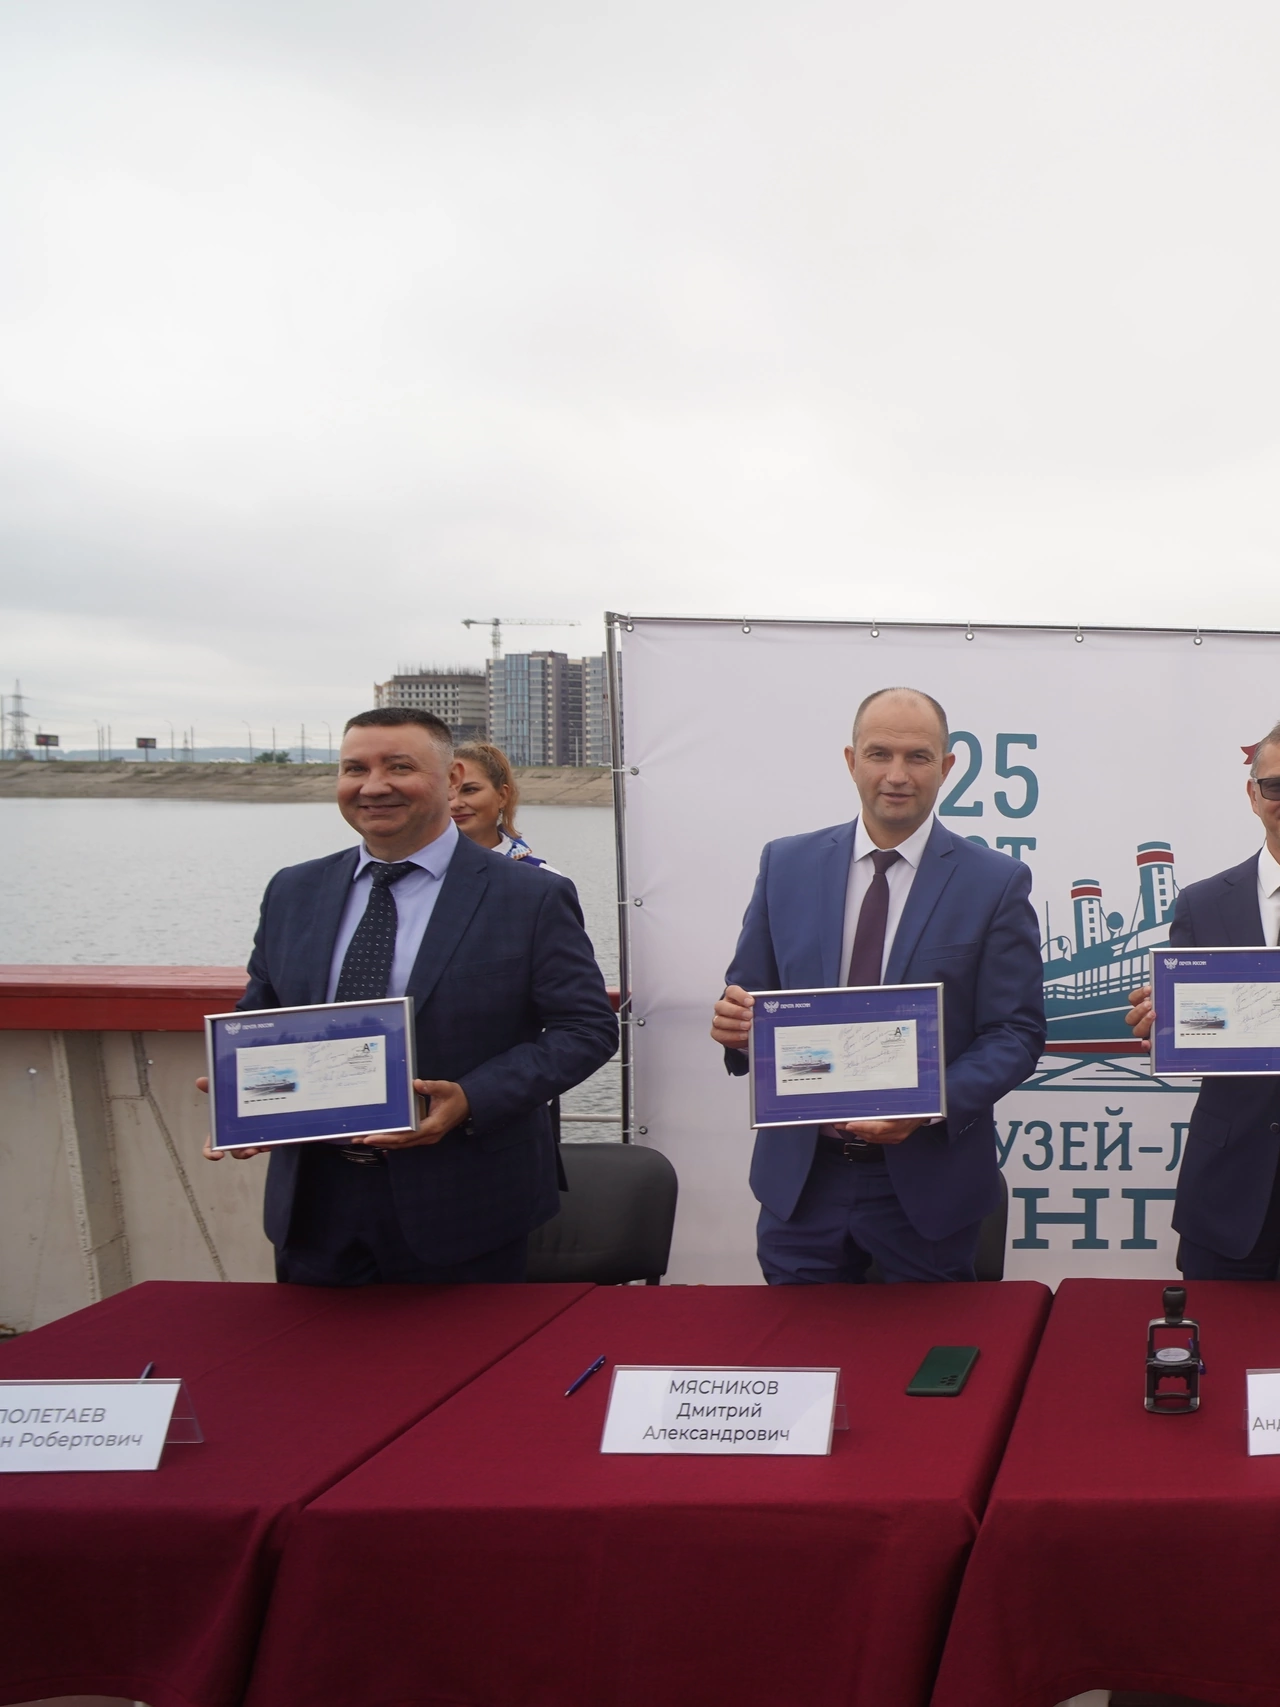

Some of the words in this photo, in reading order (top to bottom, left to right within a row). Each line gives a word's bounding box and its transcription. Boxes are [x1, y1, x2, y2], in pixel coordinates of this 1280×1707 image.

[939, 731, 1038, 818] 25
[669, 1380, 780, 1396] МЯСНИКОВ
[676, 1402, 762, 1421] Дмитрий
[19, 1431, 144, 1450] Робертович
[642, 1425, 790, 1444] Александрович
